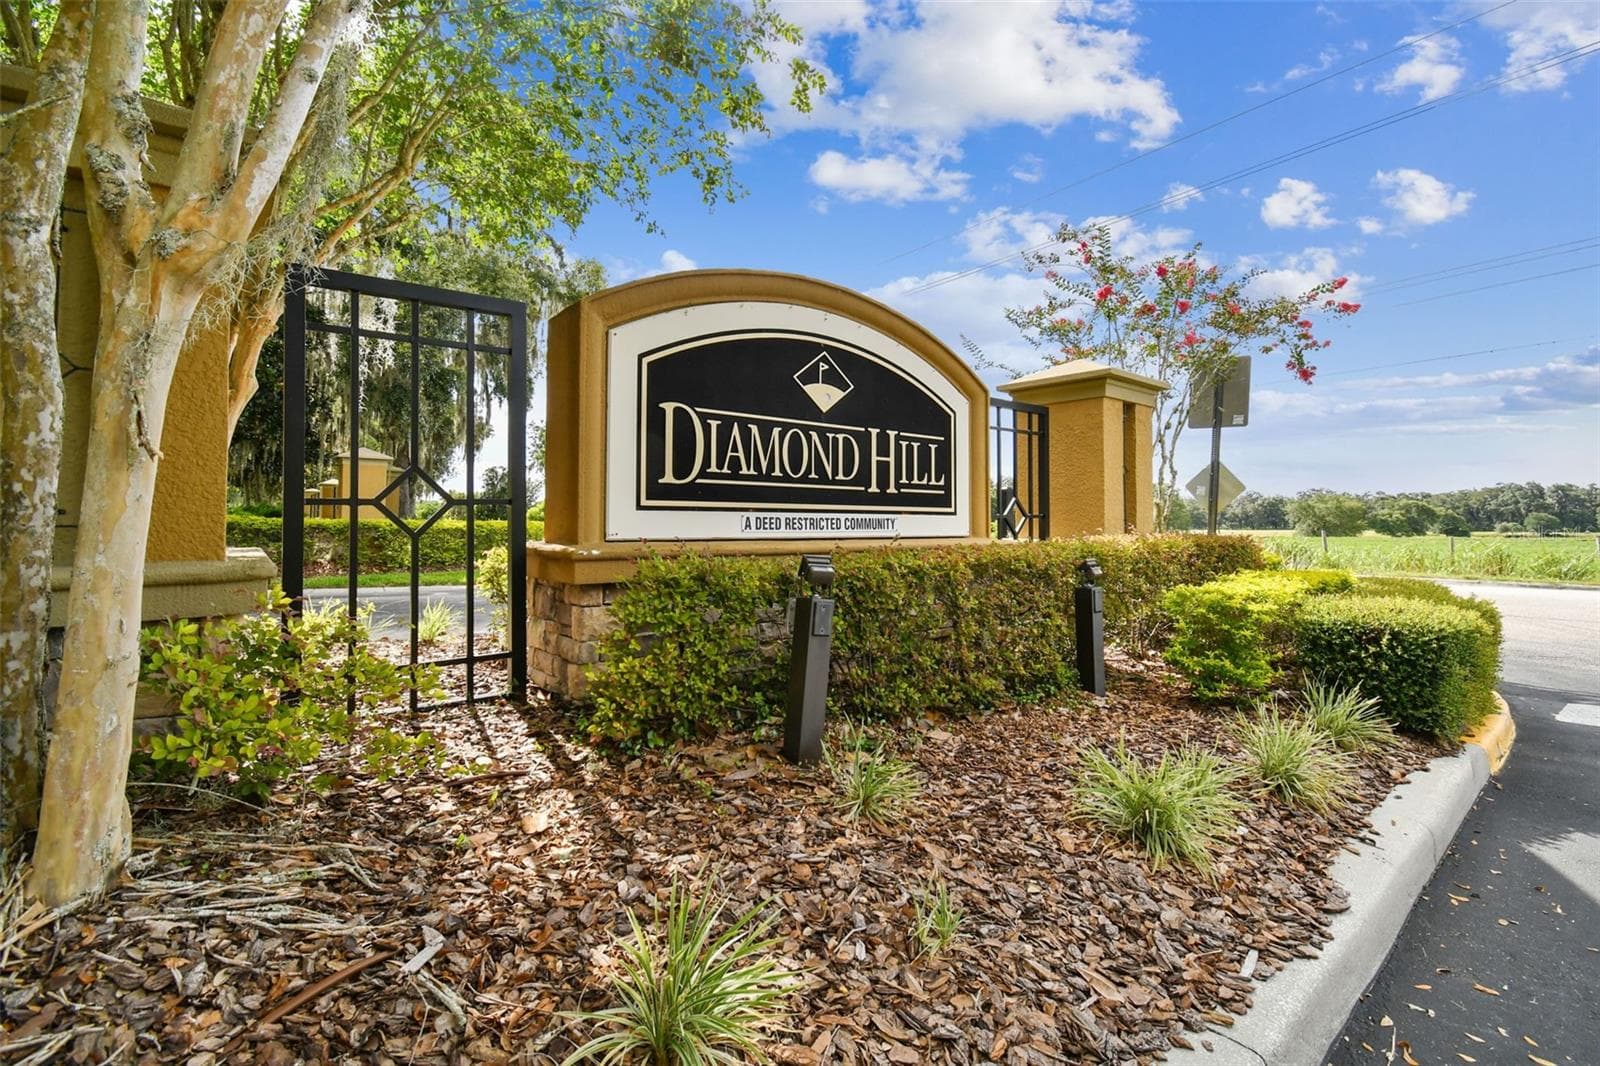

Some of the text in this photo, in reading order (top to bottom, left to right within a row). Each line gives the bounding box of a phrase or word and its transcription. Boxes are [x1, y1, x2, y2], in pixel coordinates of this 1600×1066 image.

[658, 401, 945, 494] DIAMOND HILL
[744, 516, 896, 531] A DEED RESTRICTED COMMUNITY
